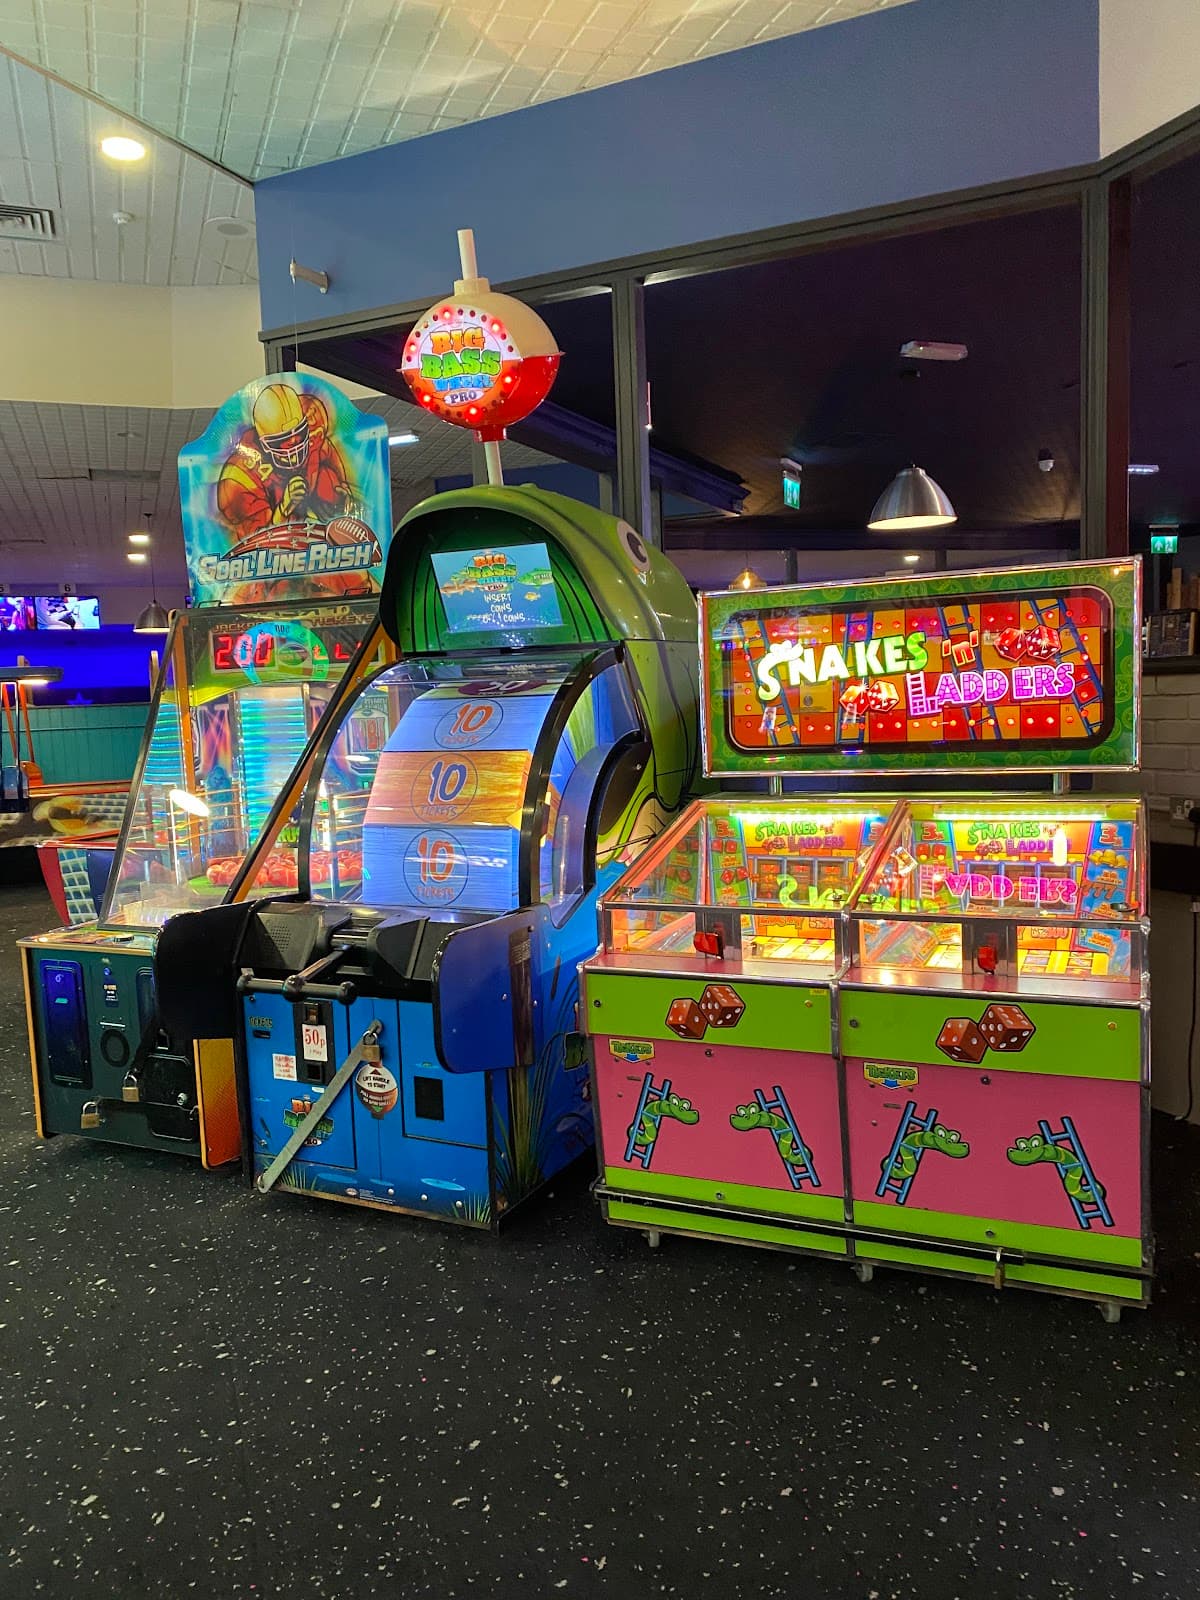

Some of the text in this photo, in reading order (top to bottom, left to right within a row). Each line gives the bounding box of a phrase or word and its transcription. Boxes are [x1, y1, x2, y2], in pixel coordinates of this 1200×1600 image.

[430, 326, 485, 355] BIG
[421, 348, 501, 379] BASS
[432, 375, 494, 392] WHEEL
[450, 390, 478, 404] PRO
[199, 542, 372, 585] GOAL LINE RUSH
[467, 564, 518, 579] BASS
[473, 553, 507, 567] BIG
[64, 583, 71, 593] 6
[483, 592, 512, 603] INSERT
[490, 603, 512, 613] COINS
[215, 635, 274, 668] 200
[757, 631, 928, 701] SNAKES
[905, 661, 1077, 717] LADDERS
[449, 703, 495, 736] 10
[427, 760, 468, 806] 10
[420, 804, 457, 818] TICKETS
[755, 820, 819, 842] SNAKES
[968, 821, 1041, 846] SNAKES
[417, 836, 456, 884] 10
[304, 1028, 326, 1048] 50p
